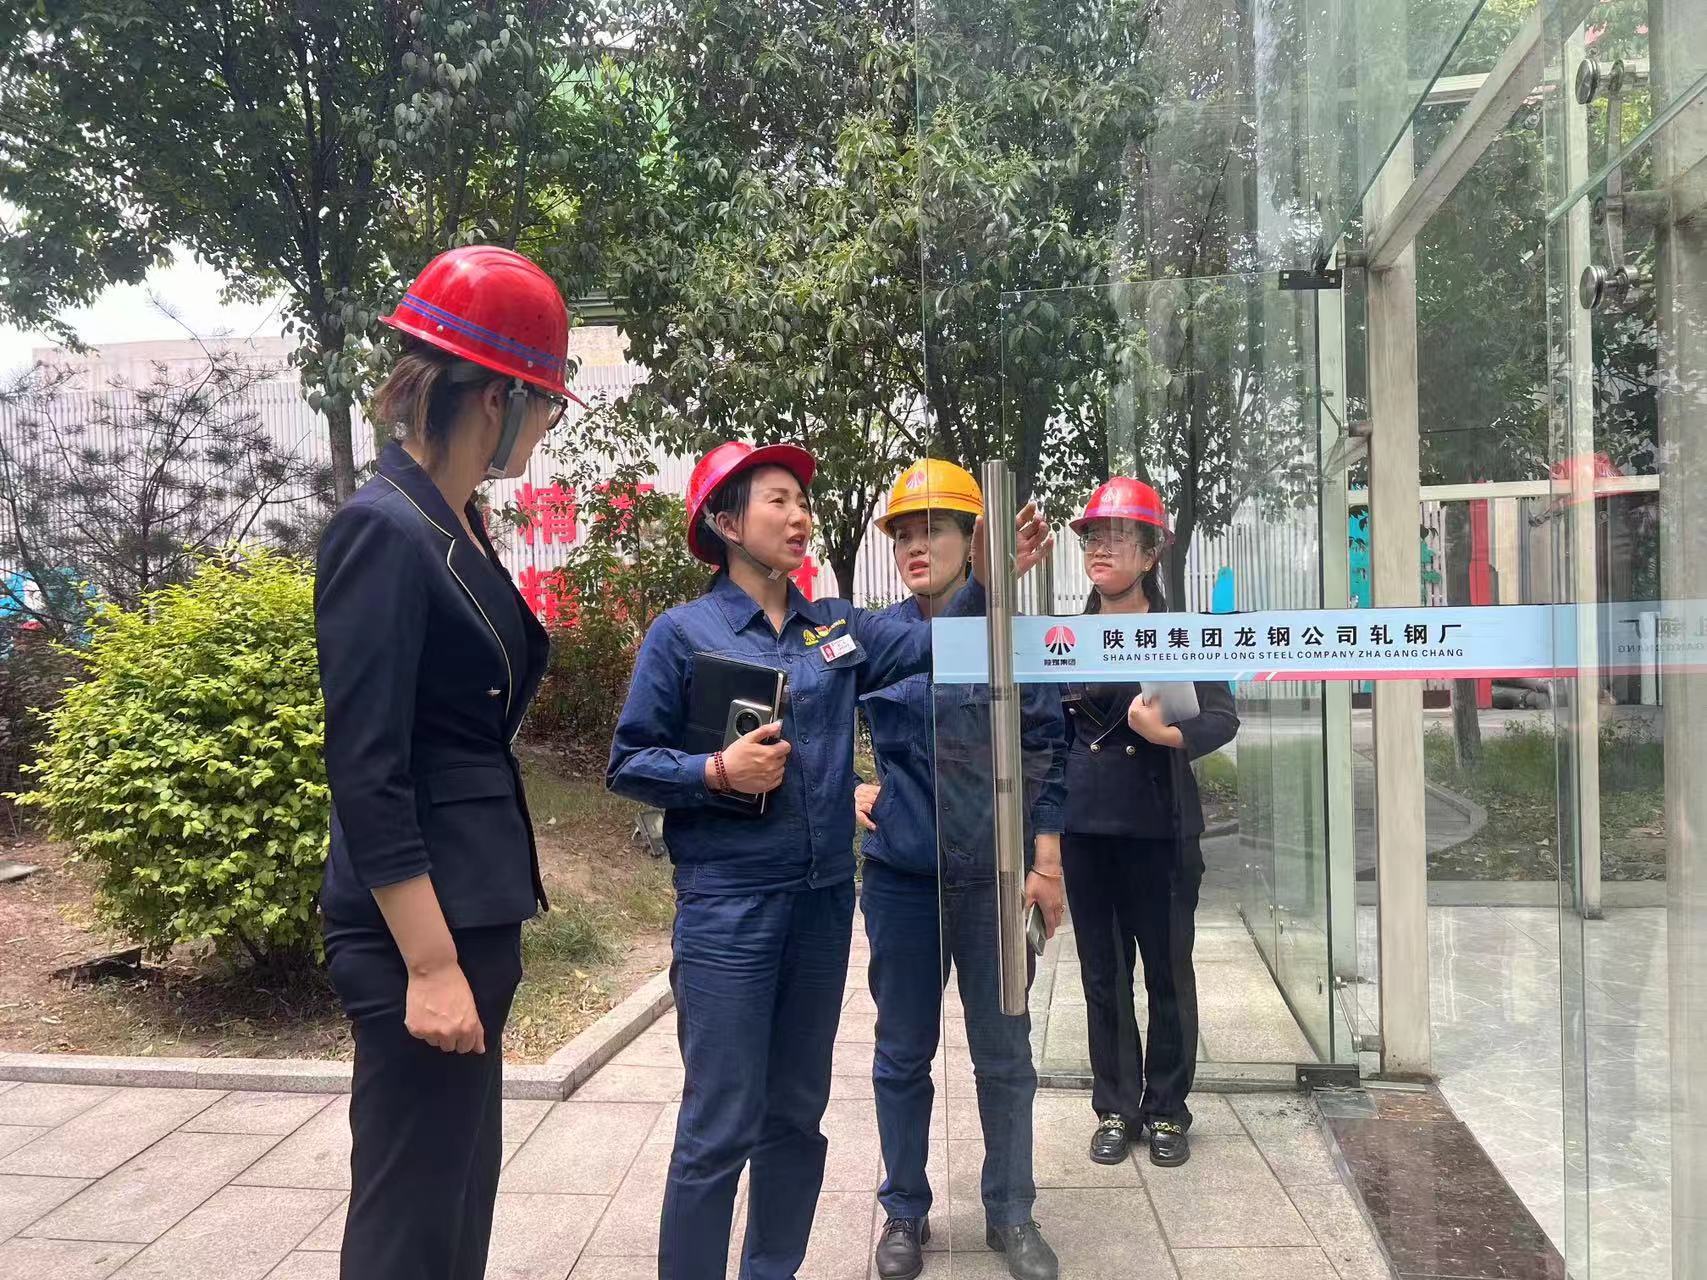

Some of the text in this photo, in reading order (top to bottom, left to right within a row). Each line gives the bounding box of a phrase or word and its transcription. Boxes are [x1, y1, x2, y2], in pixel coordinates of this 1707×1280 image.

[1103, 624, 1462, 649] 陕钢集团龙钢公司轧钢厂
[1102, 648, 1463, 662] SHAAN STEEL GROUP LONG STEEL COMPANY ZHA GANG CHANG
